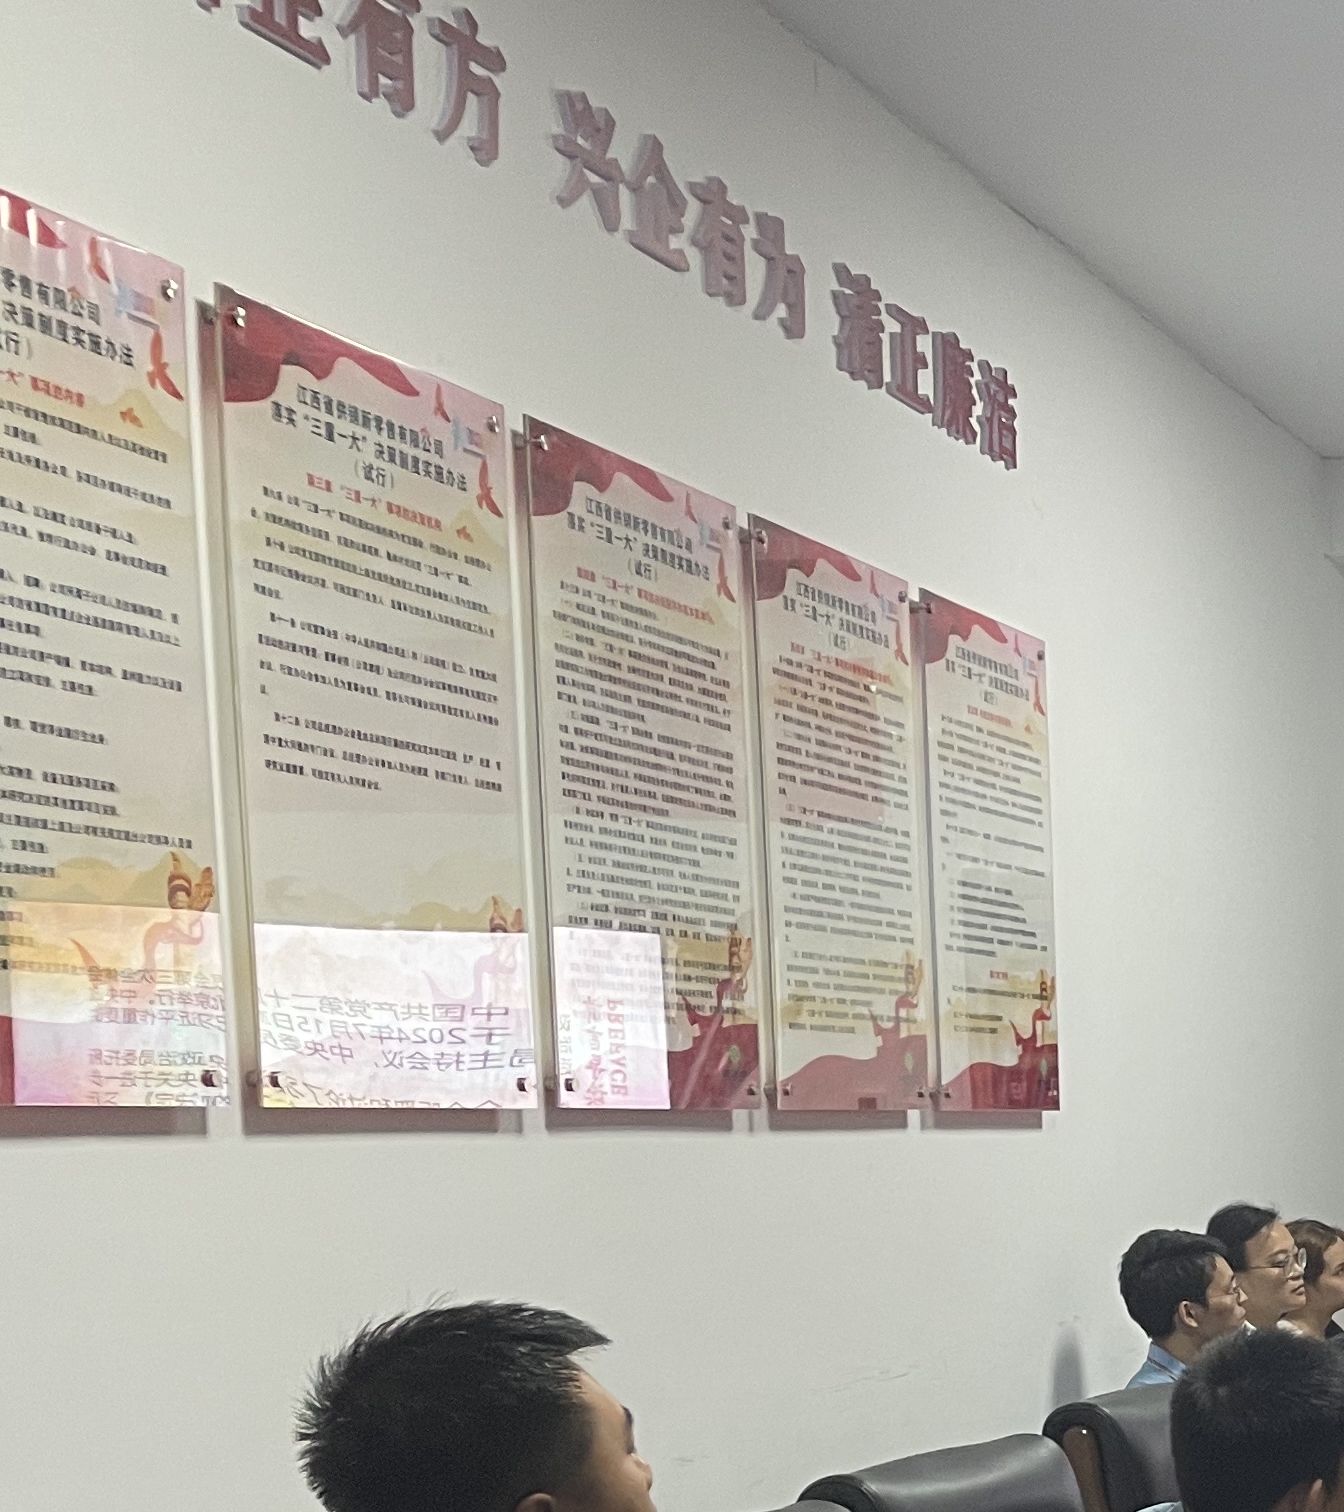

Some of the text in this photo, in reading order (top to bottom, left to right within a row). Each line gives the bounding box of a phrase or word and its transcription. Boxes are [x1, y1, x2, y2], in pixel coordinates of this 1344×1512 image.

[552, 89, 806, 340] 兴企有为
[831, 262, 1018, 471] 清正廉洁
